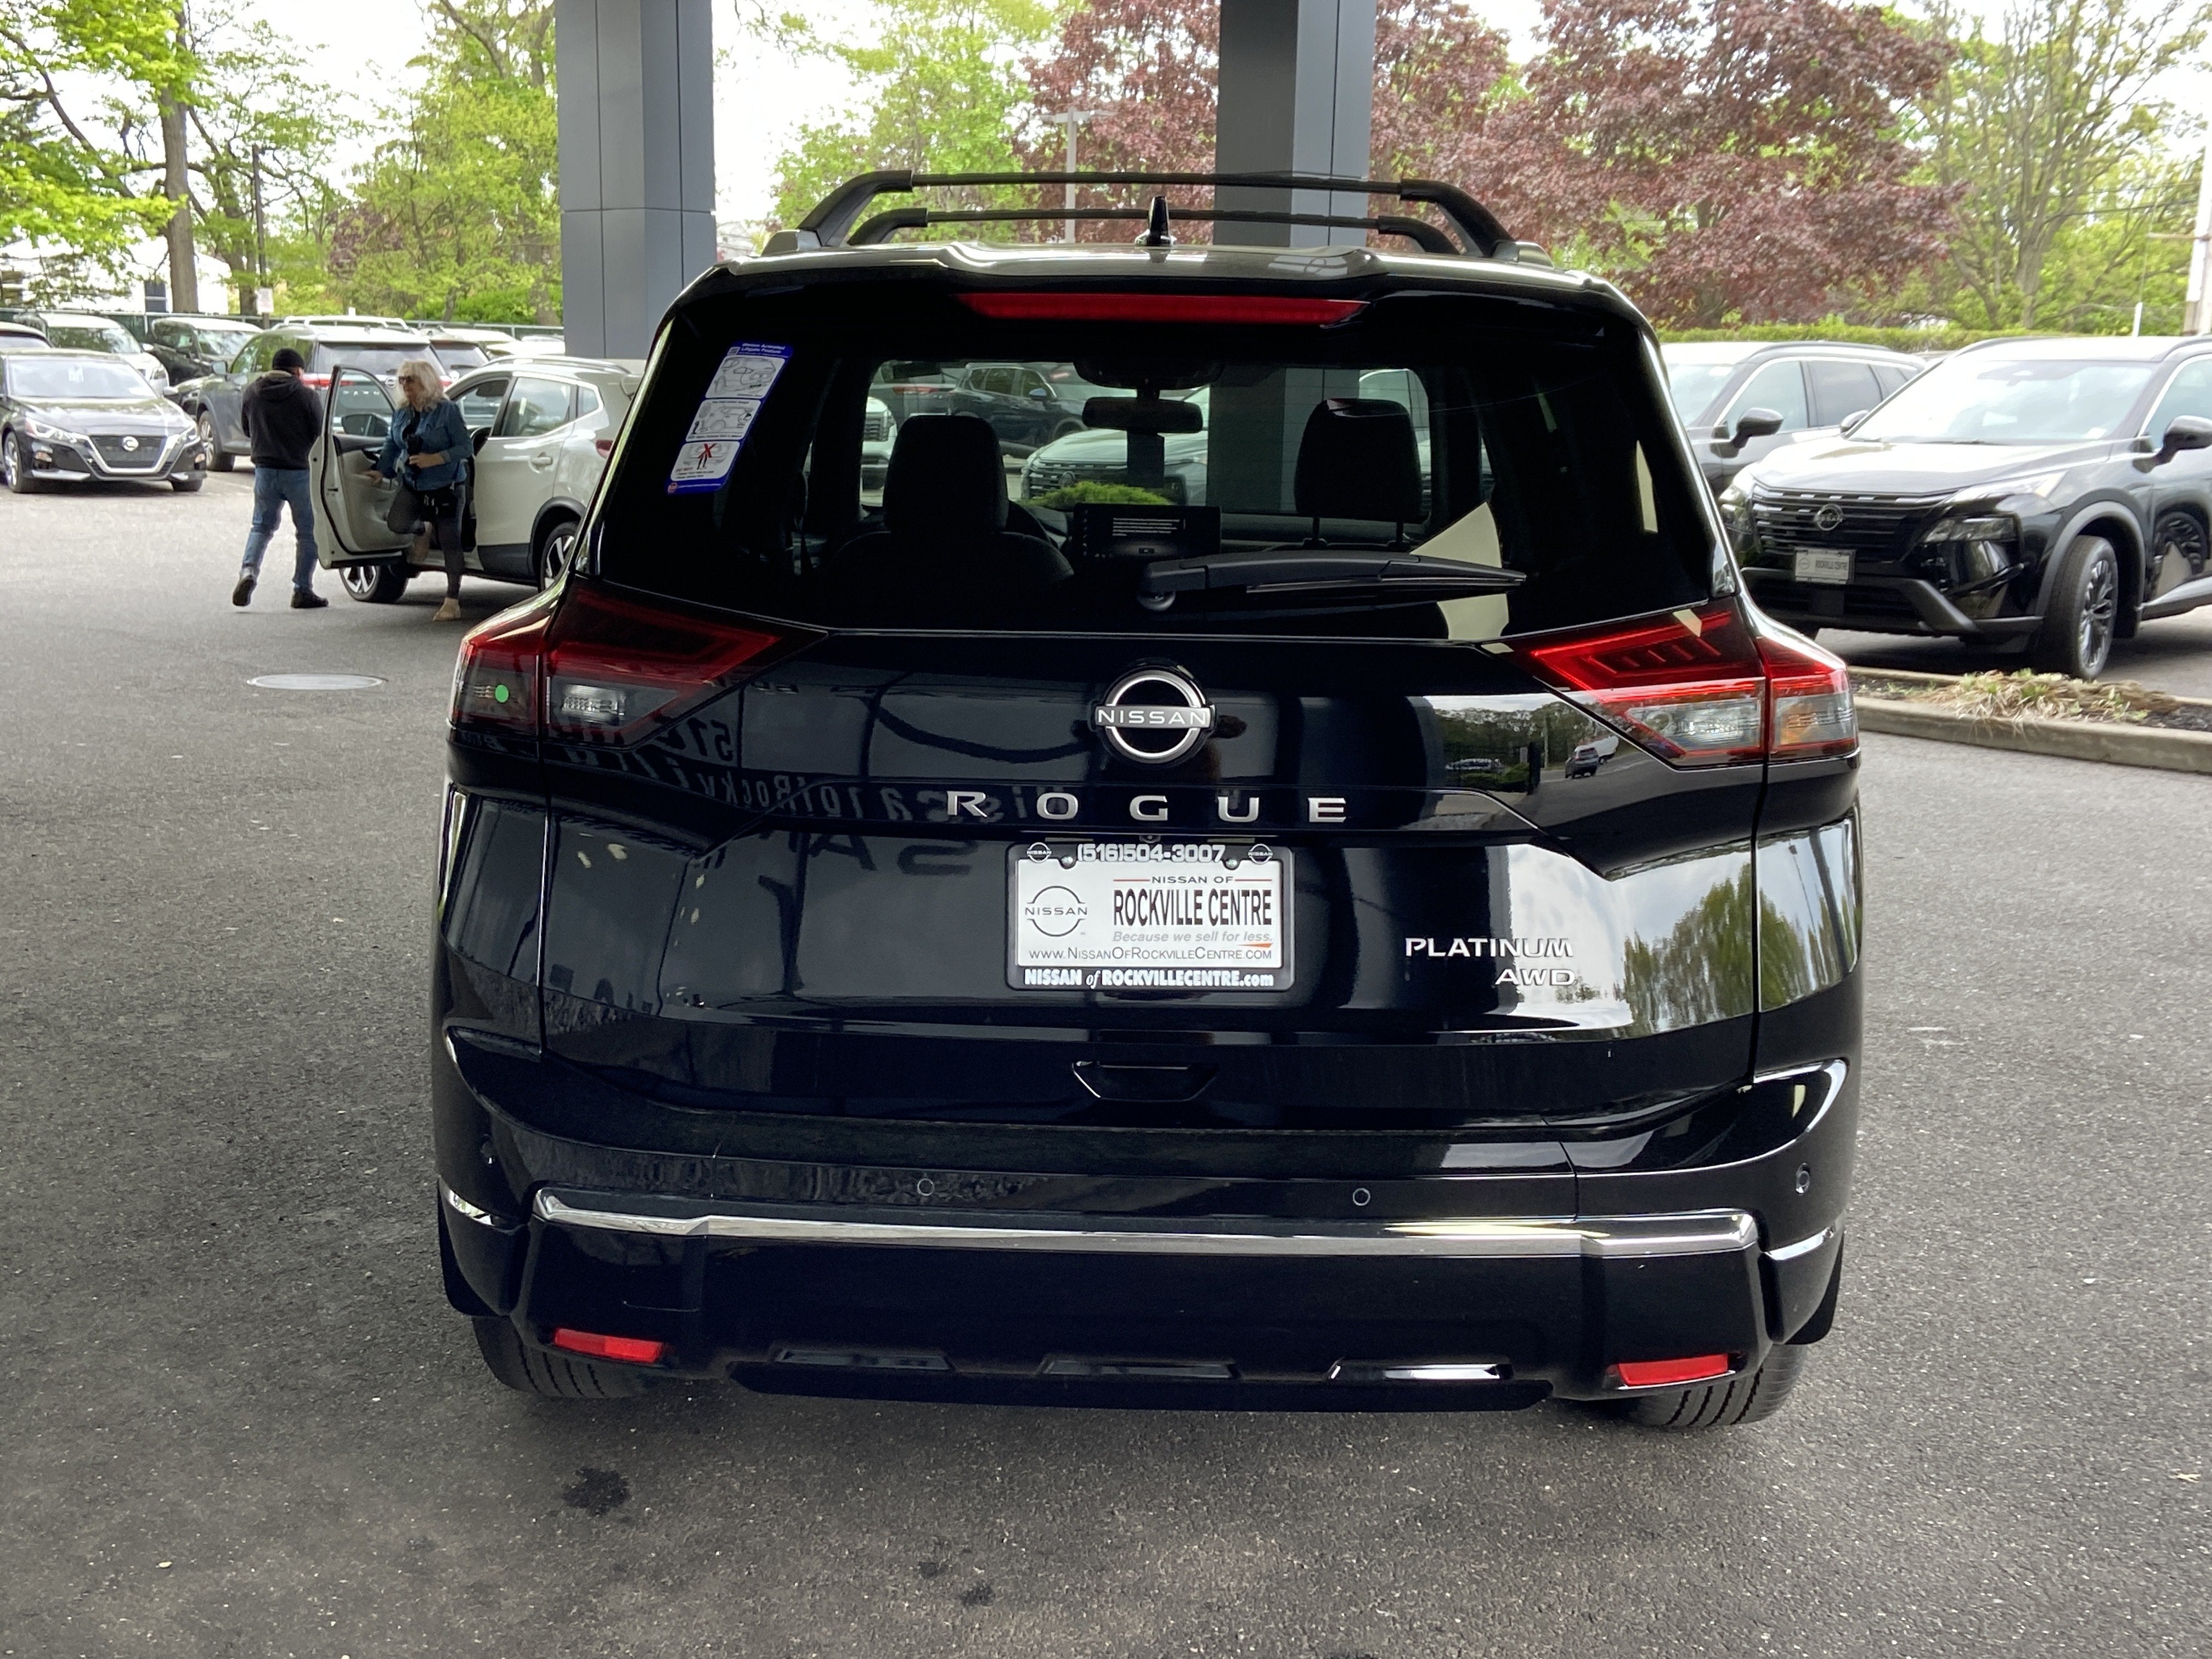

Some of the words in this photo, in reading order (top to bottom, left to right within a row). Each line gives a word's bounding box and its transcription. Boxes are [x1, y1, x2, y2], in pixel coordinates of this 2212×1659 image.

[1098, 709, 1206, 725] NISSAN
[946, 791, 1346, 823] ROGUE
[1077, 844, 1226, 863] (516)504-3007
[1025, 907, 1087, 915] NISSAN
[1114, 888, 1203, 926] ROCKVILLE
[1208, 888, 1272, 926] CENTRE
[1113, 932, 1169, 942] Because
[1173, 934, 1192, 942] we
[1195, 932, 1218, 942] sell
[1222, 932, 1240, 942] for
[1244, 932, 1273, 942] less.
[1405, 938, 1573, 957] PLATINUM
[1024, 969, 1082, 986] NISSAN
[1085, 970, 1101, 989] of
[1102, 969, 1274, 986] ROCKVILLECENTRE.com
[1495, 968, 1576, 986] AWD
